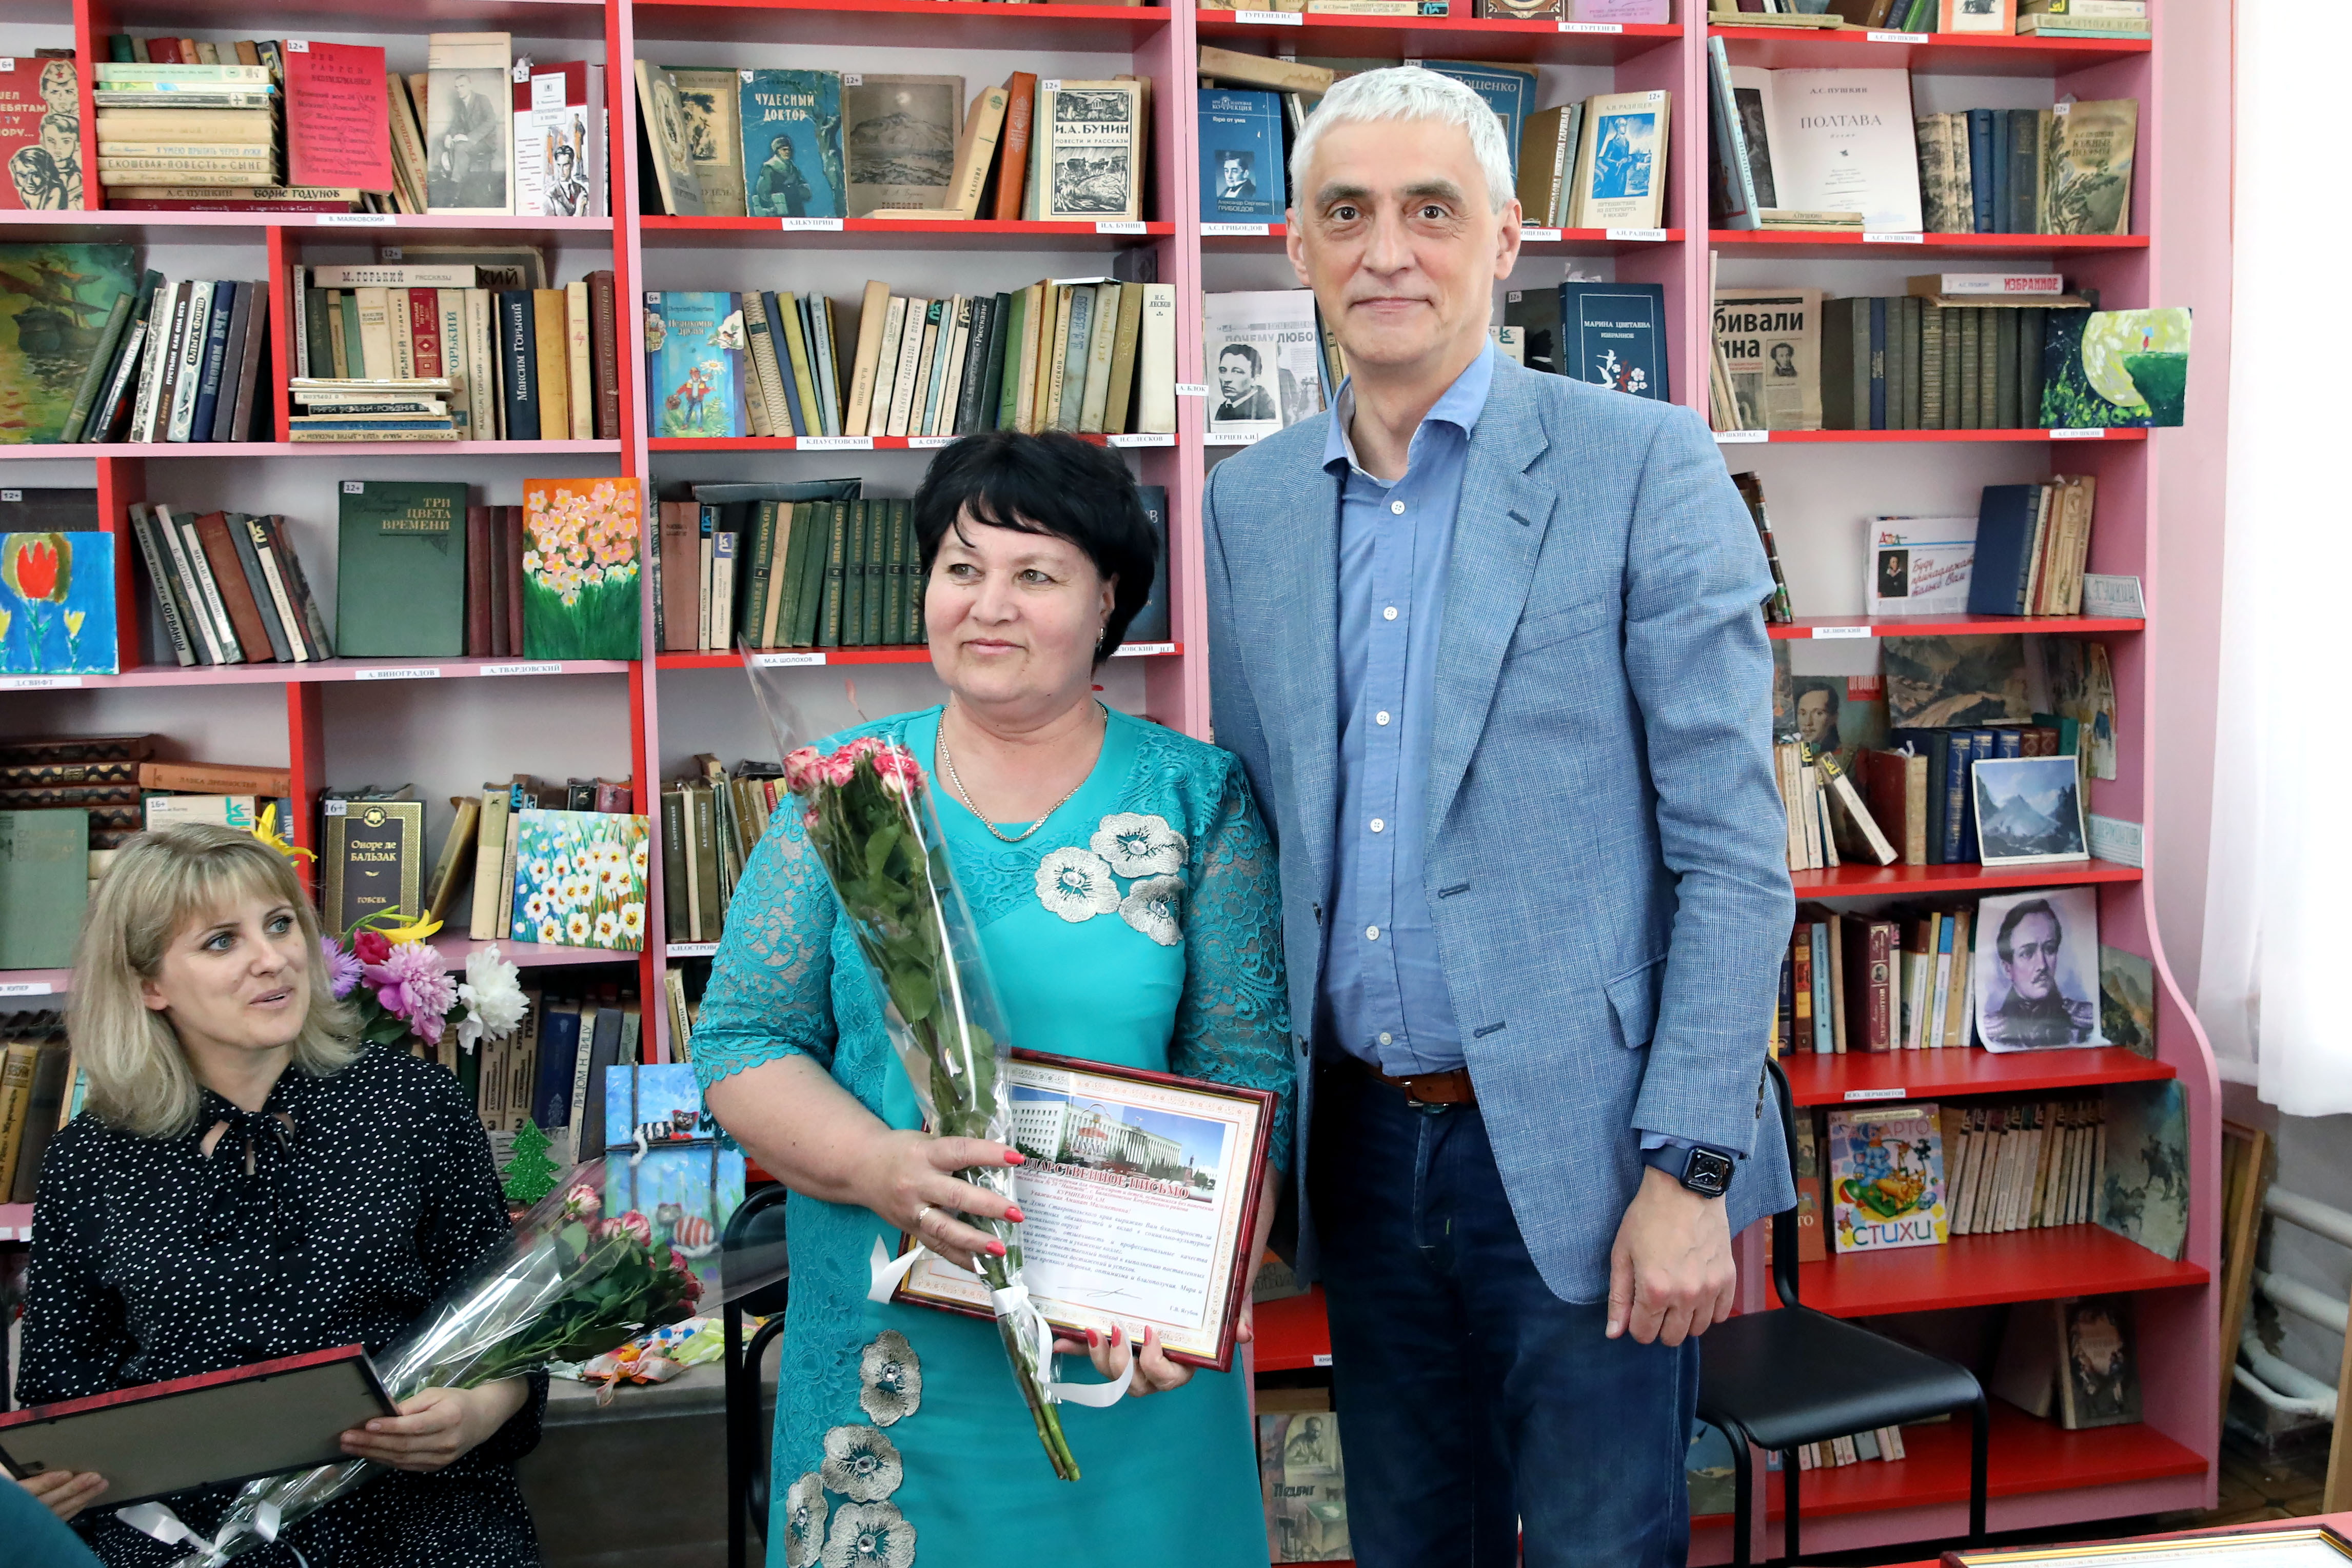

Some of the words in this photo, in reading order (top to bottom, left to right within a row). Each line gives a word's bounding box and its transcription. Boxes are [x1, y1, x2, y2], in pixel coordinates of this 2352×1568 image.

[755, 91, 815, 107] ЧУДЕСНЫЙ
[763, 109, 806, 122] ДОКТОР
[1800, 114, 1882, 129] ПОЛТАВА
[2004, 277, 2059, 291] ИЗБРАННОЕ
[191, 298, 205, 329] ФОРШ
[175, 318, 183, 333] ОНА
[511, 303, 525, 352] Горький
[1615, 321, 1651, 329] ЦВЕТАЕВА
[171, 333, 180, 350] КАК
[187, 331, 200, 363] ОЛЬГА
[166, 351, 177, 386] ПУСТЫНЯ
[516, 355, 528, 401] Максим
[423, 498, 451, 507] ТРИ
[406, 508, 451, 519] ЦВЕТА
[382, 520, 450, 530] ВРЕМЕНИ
[175, 555, 193, 589] ЖИТКОВ
[193, 549, 208, 579] МИХАИЛ
[162, 602, 186, 652] СОРВАНЦЫ
[378, 669, 435, 678] ВИНОГРАДОВ
[499, 664, 561, 673] ТВАРДОВСКИЙ
[350, 840, 382, 851] Оноре
[384, 840, 397, 851] де
[350, 851, 397, 863] БАЛЬЗАК
[358, 896, 387, 904] ГОБСЕК
[580, 1024, 592, 1054] ЛИЦУ
[574, 1070, 588, 1109] ЛИЦОМ
[487, 1120, 497, 1130] 3
[515, 1118, 524, 1129] 2
[1129, 1177, 1190, 1199] ПИСЬМО
[1047, 1202, 1097, 1218] Ставропольского
[1114, 1217, 1143, 1227] выражаю
[1159, 1225, 1203, 1239] благодарность
[1073, 1241, 1102, 1252] уважение
[1144, 1231, 1211, 1248] социально-культурное
[1069, 1254, 1107, 1267] достижений
[1120, 1241, 1175, 1257] профессиональные
[1180, 1253, 1208, 1264] качества
[1050, 1243, 1098, 1257] ответственный
[1098, 1252, 1119, 1261] подход
[1124, 1258, 1161, 1270] выполнению
[1162, 1266, 1205, 1279] поставленных
[1039, 1256, 1065, 1266] крепкого
[1179, 1284, 1197, 1295] Мира
